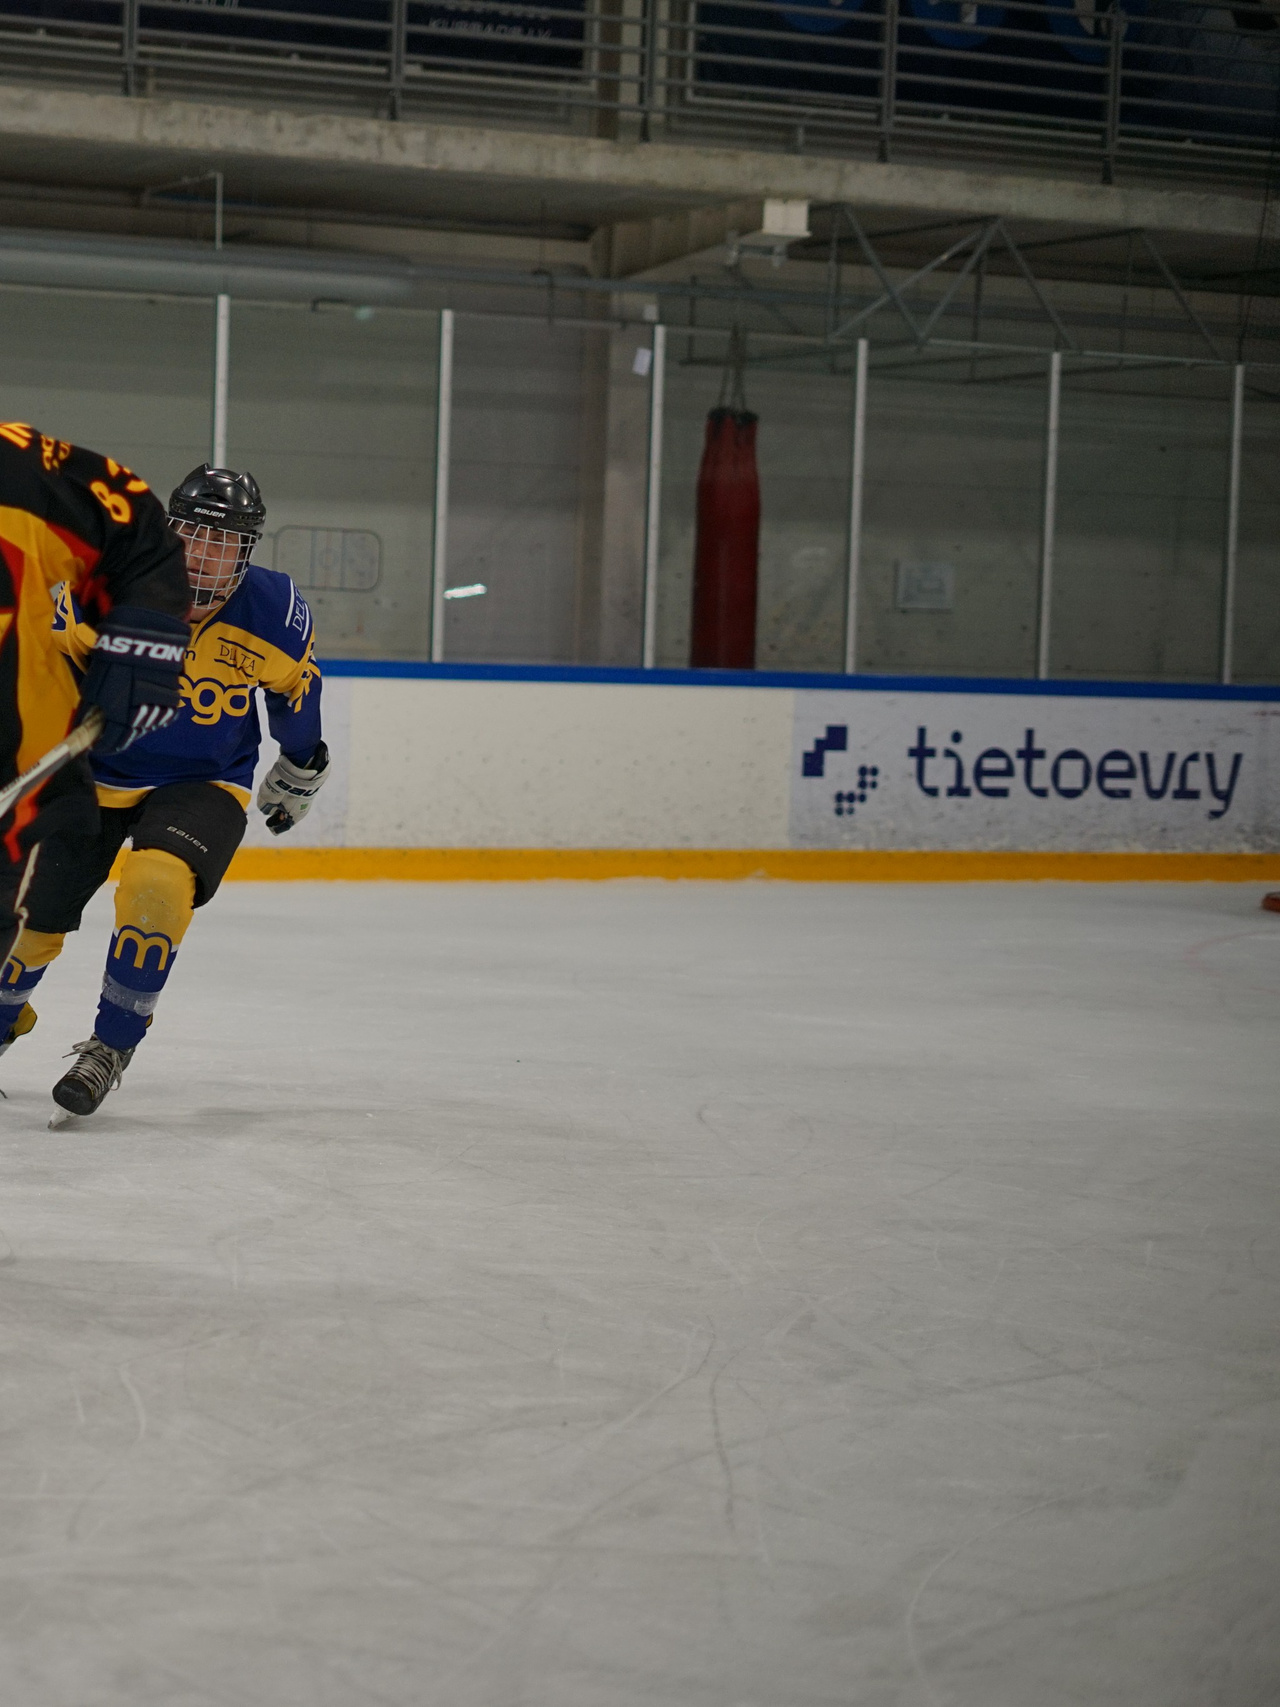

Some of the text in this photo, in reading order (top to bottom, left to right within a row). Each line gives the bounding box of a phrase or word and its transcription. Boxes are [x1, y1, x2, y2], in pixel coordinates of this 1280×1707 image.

[292, 584, 305, 632] DELT
[94, 633, 185, 662] ASTON
[177, 675, 250, 726] ego
[274, 778, 320, 797] BAU
[907, 726, 1244, 820] tietoevry
